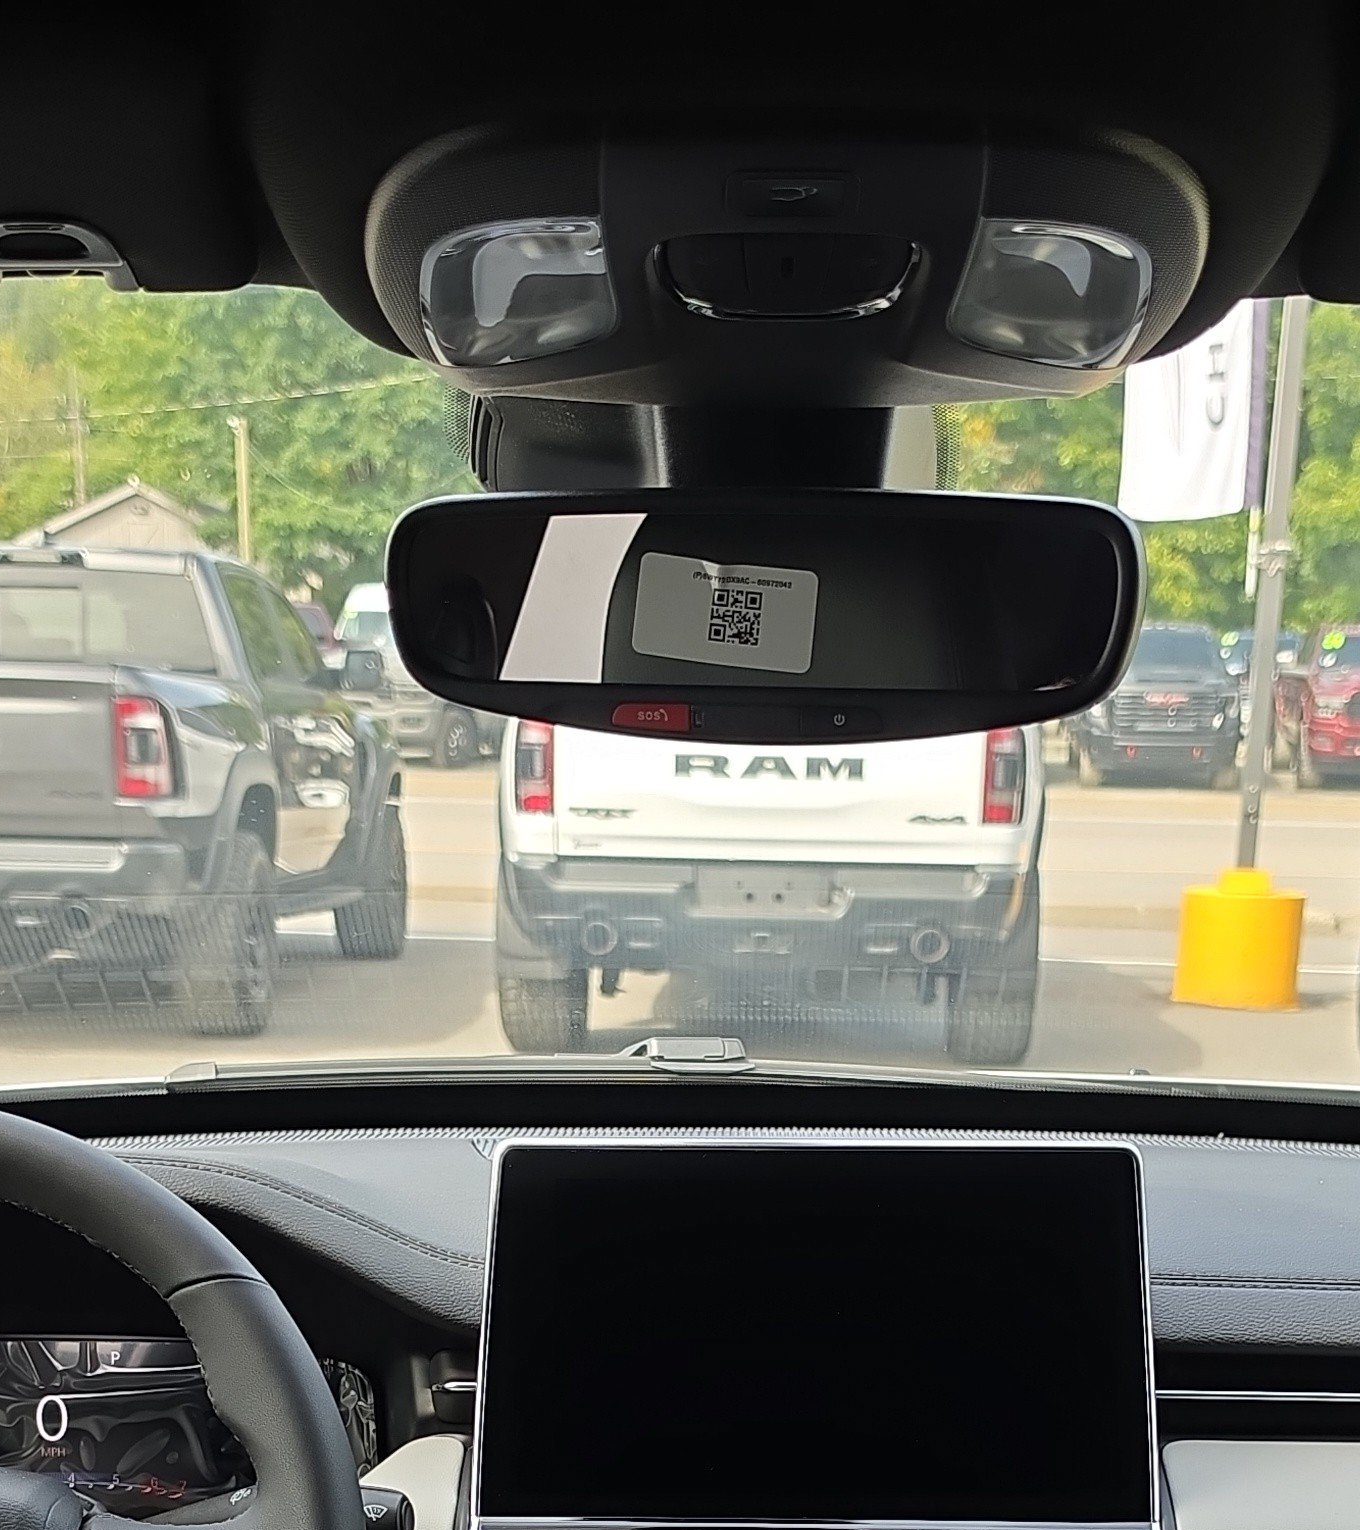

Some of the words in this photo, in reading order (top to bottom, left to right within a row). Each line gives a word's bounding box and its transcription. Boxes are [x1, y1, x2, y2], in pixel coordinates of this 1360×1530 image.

[637, 711, 660, 721] SOS
[674, 754, 865, 781] RAM
[110, 1351, 121, 1366] P
[36, 1395, 68, 1442] 0
[41, 1447, 66, 1458] MPH
[112, 1474, 120, 1484] 5
[151, 1478, 158, 1488] 6
